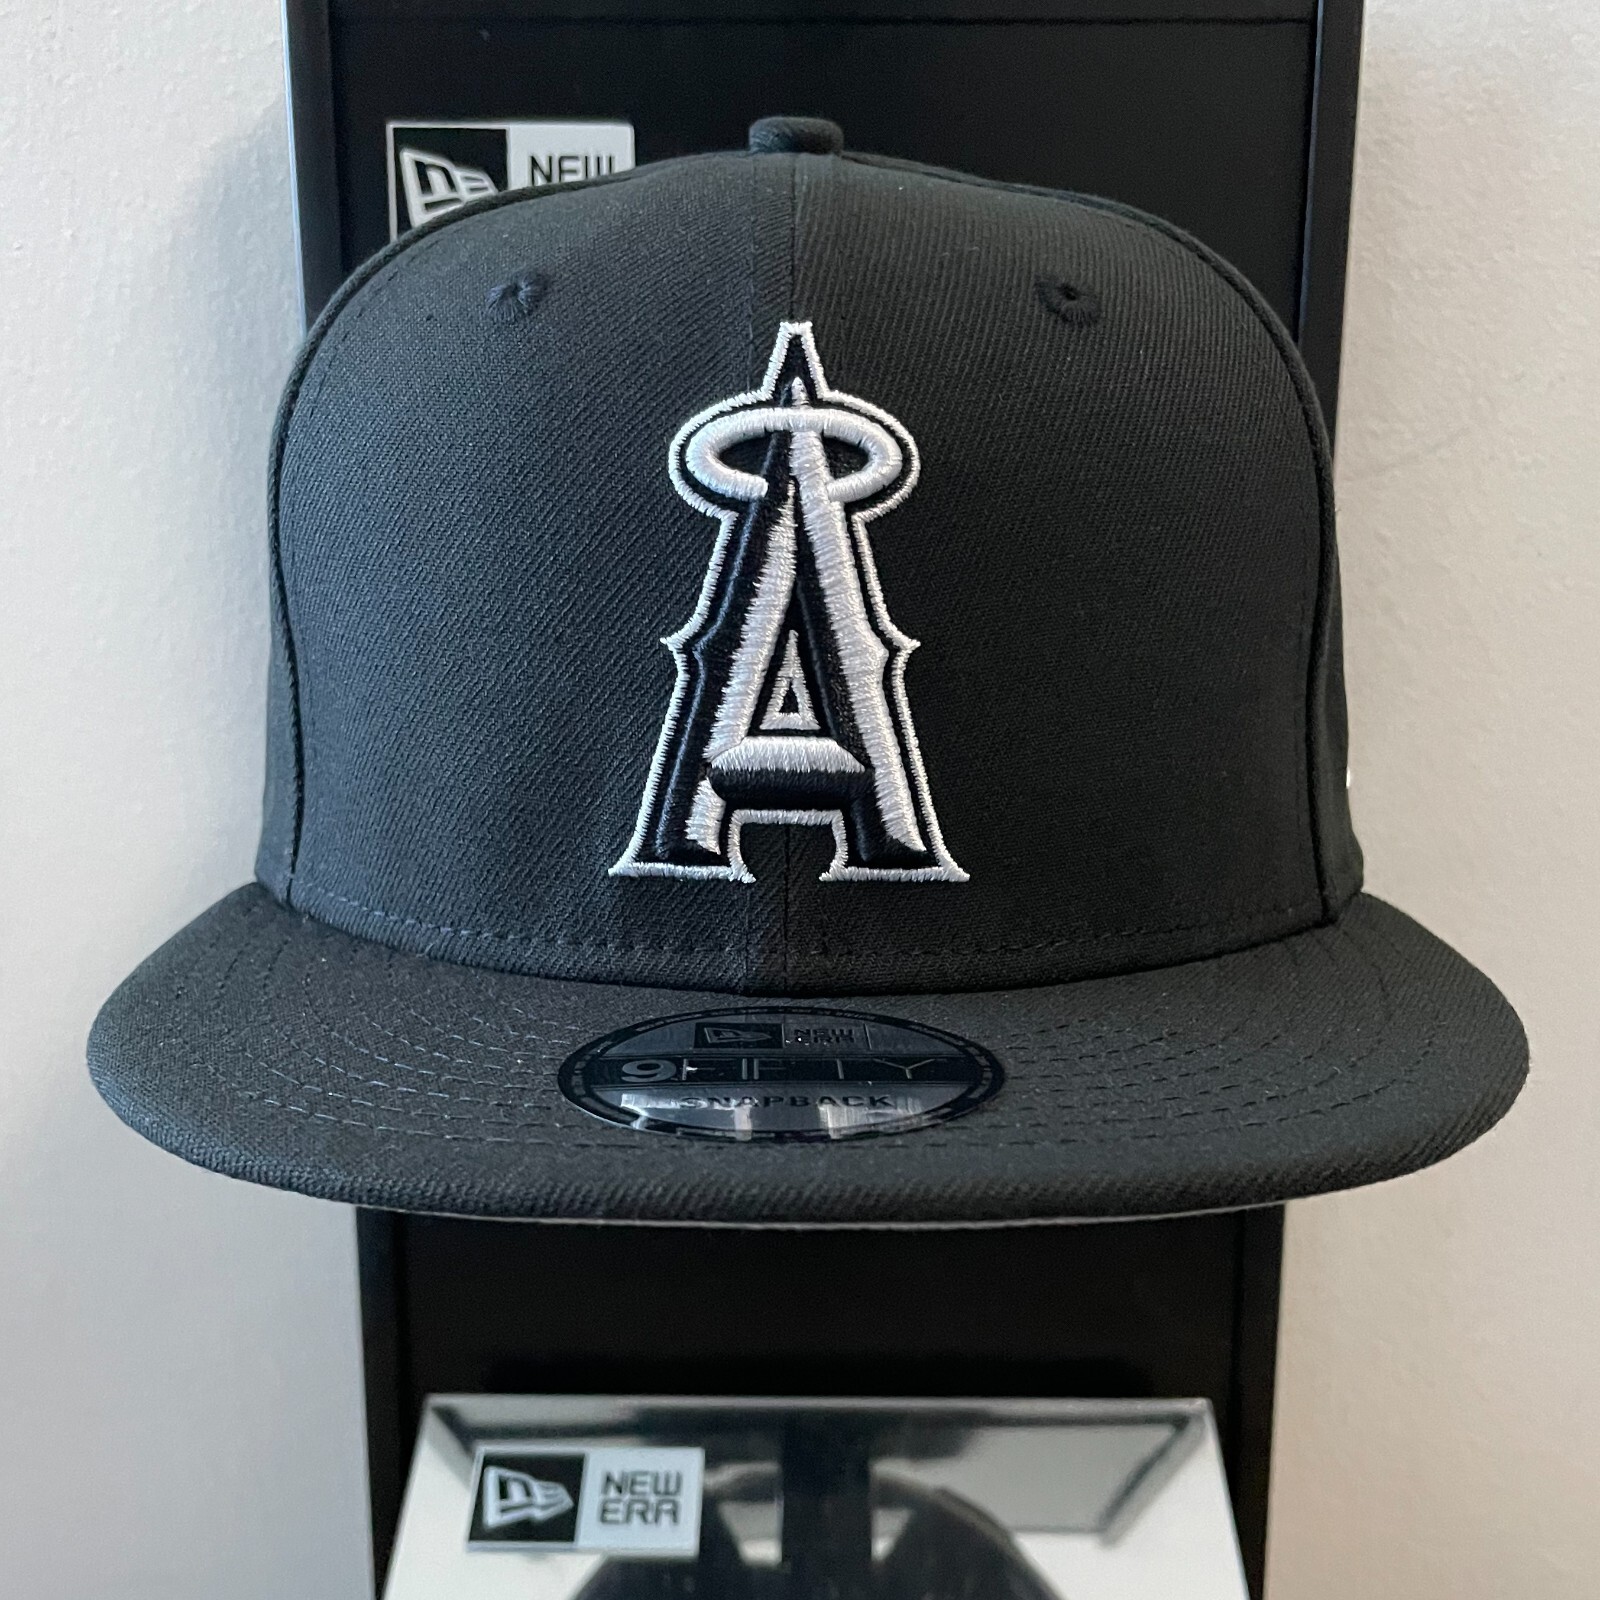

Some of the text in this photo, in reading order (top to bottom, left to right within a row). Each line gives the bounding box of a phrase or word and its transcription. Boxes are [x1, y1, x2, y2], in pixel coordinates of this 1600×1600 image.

[531, 155, 616, 185] NEW
[607, 322, 970, 882] A
[678, 1096, 895, 1108] SNAPBACK
[602, 1470, 683, 1496] NEW
[600, 1501, 680, 1525] ERA
